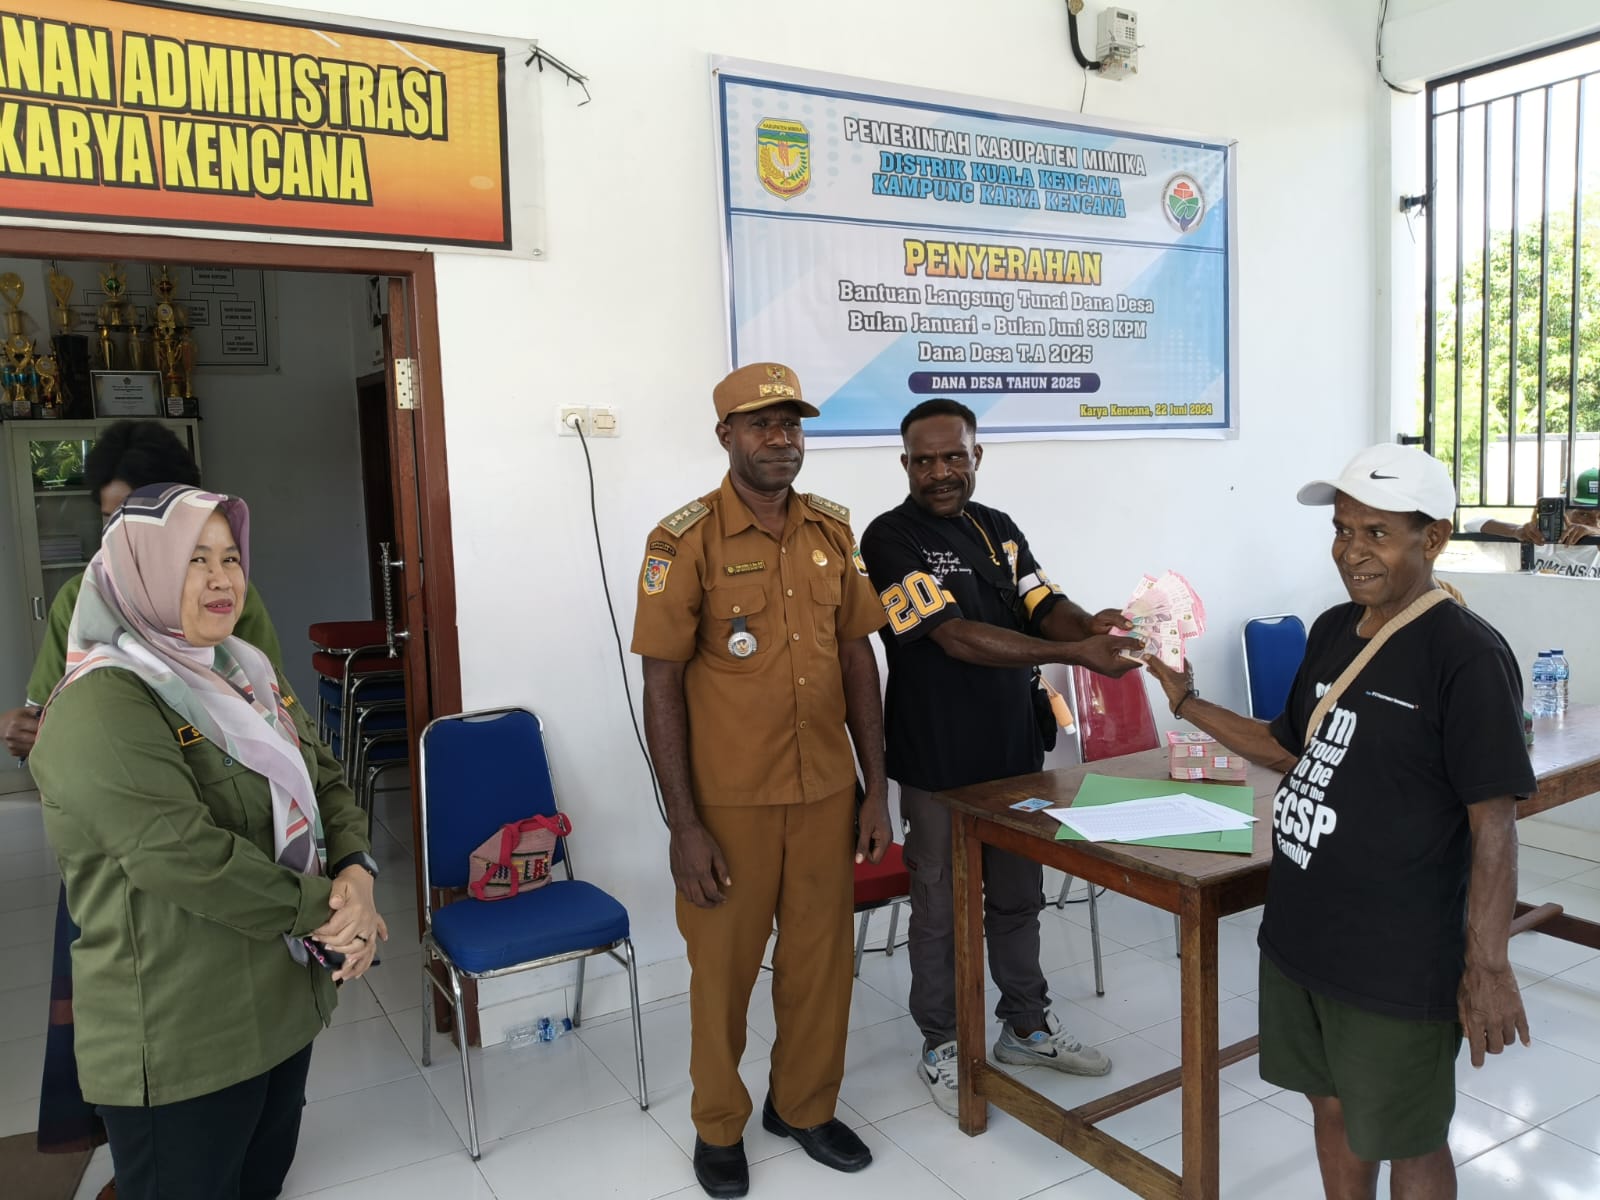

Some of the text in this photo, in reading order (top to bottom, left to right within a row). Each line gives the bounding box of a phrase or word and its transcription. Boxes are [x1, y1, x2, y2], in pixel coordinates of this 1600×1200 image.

[0, 14, 446, 139] NAN ADMINISTRASI
[0, 100, 372, 205] KARYA KENCANA
[844, 117, 1146, 176] PEMERINTAH KABUPATEN MIMIKA
[880, 151, 1121, 197] DISTRIK KUALA KENCANA
[872, 173, 1126, 218] KAMPUNG KARYA KENCANA
[904, 239, 1102, 285] PENYERAHAN
[839, 280, 1154, 313] Bantuan Langsung Tunai Dana Desa
[848, 310, 907, 332] Bulan
[911, 313, 978, 334] Januari
[994, 315, 1045, 336] Bulan
[1050, 318, 1083, 337] Juni
[1087, 318, 1109, 338] 36
[1113, 320, 1147, 339] KPM
[918, 341, 1093, 363] Dana Desa T.A 2025
[932, 376, 1081, 389] DANA DESA TAHUN 2025
[1080, 403, 1213, 419] Karya Kencana, 22 Juni 2024
[880, 570, 946, 635] 20
[1308, 760, 1334, 787] be
[1309, 786, 1325, 802] the
[1273, 786, 1337, 849] ECSP
[1276, 832, 1312, 871] Family
